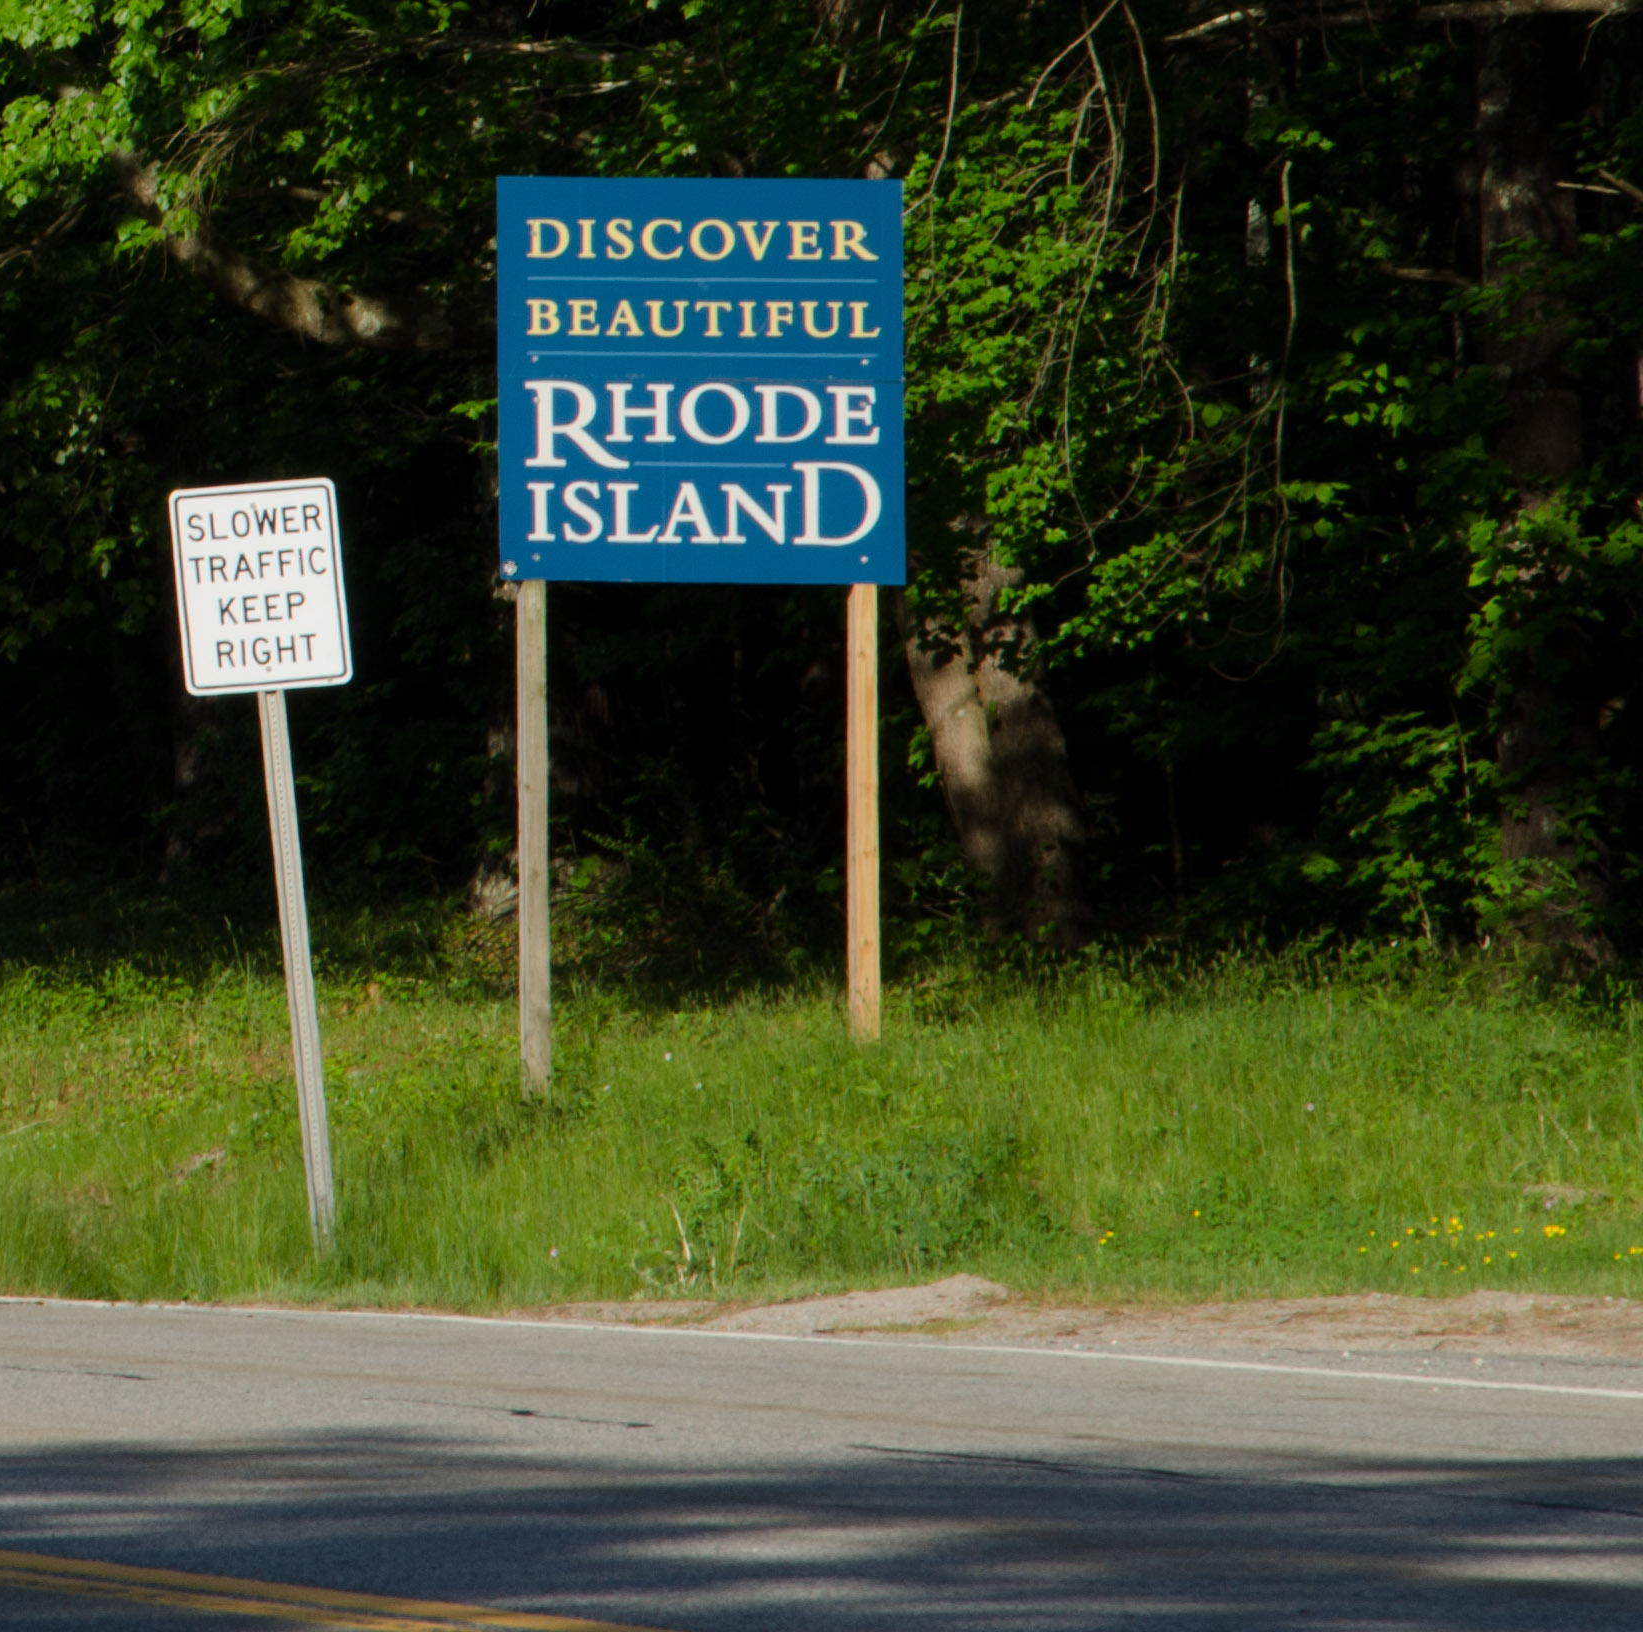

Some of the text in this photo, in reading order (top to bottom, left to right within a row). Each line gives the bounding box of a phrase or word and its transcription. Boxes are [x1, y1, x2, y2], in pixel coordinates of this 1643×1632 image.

[525, 218, 879, 262] DISCOVER
[525, 298, 881, 339] BEAUTIFUL
[524, 379, 881, 470] RHODE
[187, 503, 323, 542] SLOWER
[526, 461, 883, 547] ISLAND
[188, 546, 328, 584] TRAFFIC
[218, 591, 306, 626] KEEP
[216, 633, 317, 669] RIGHT
